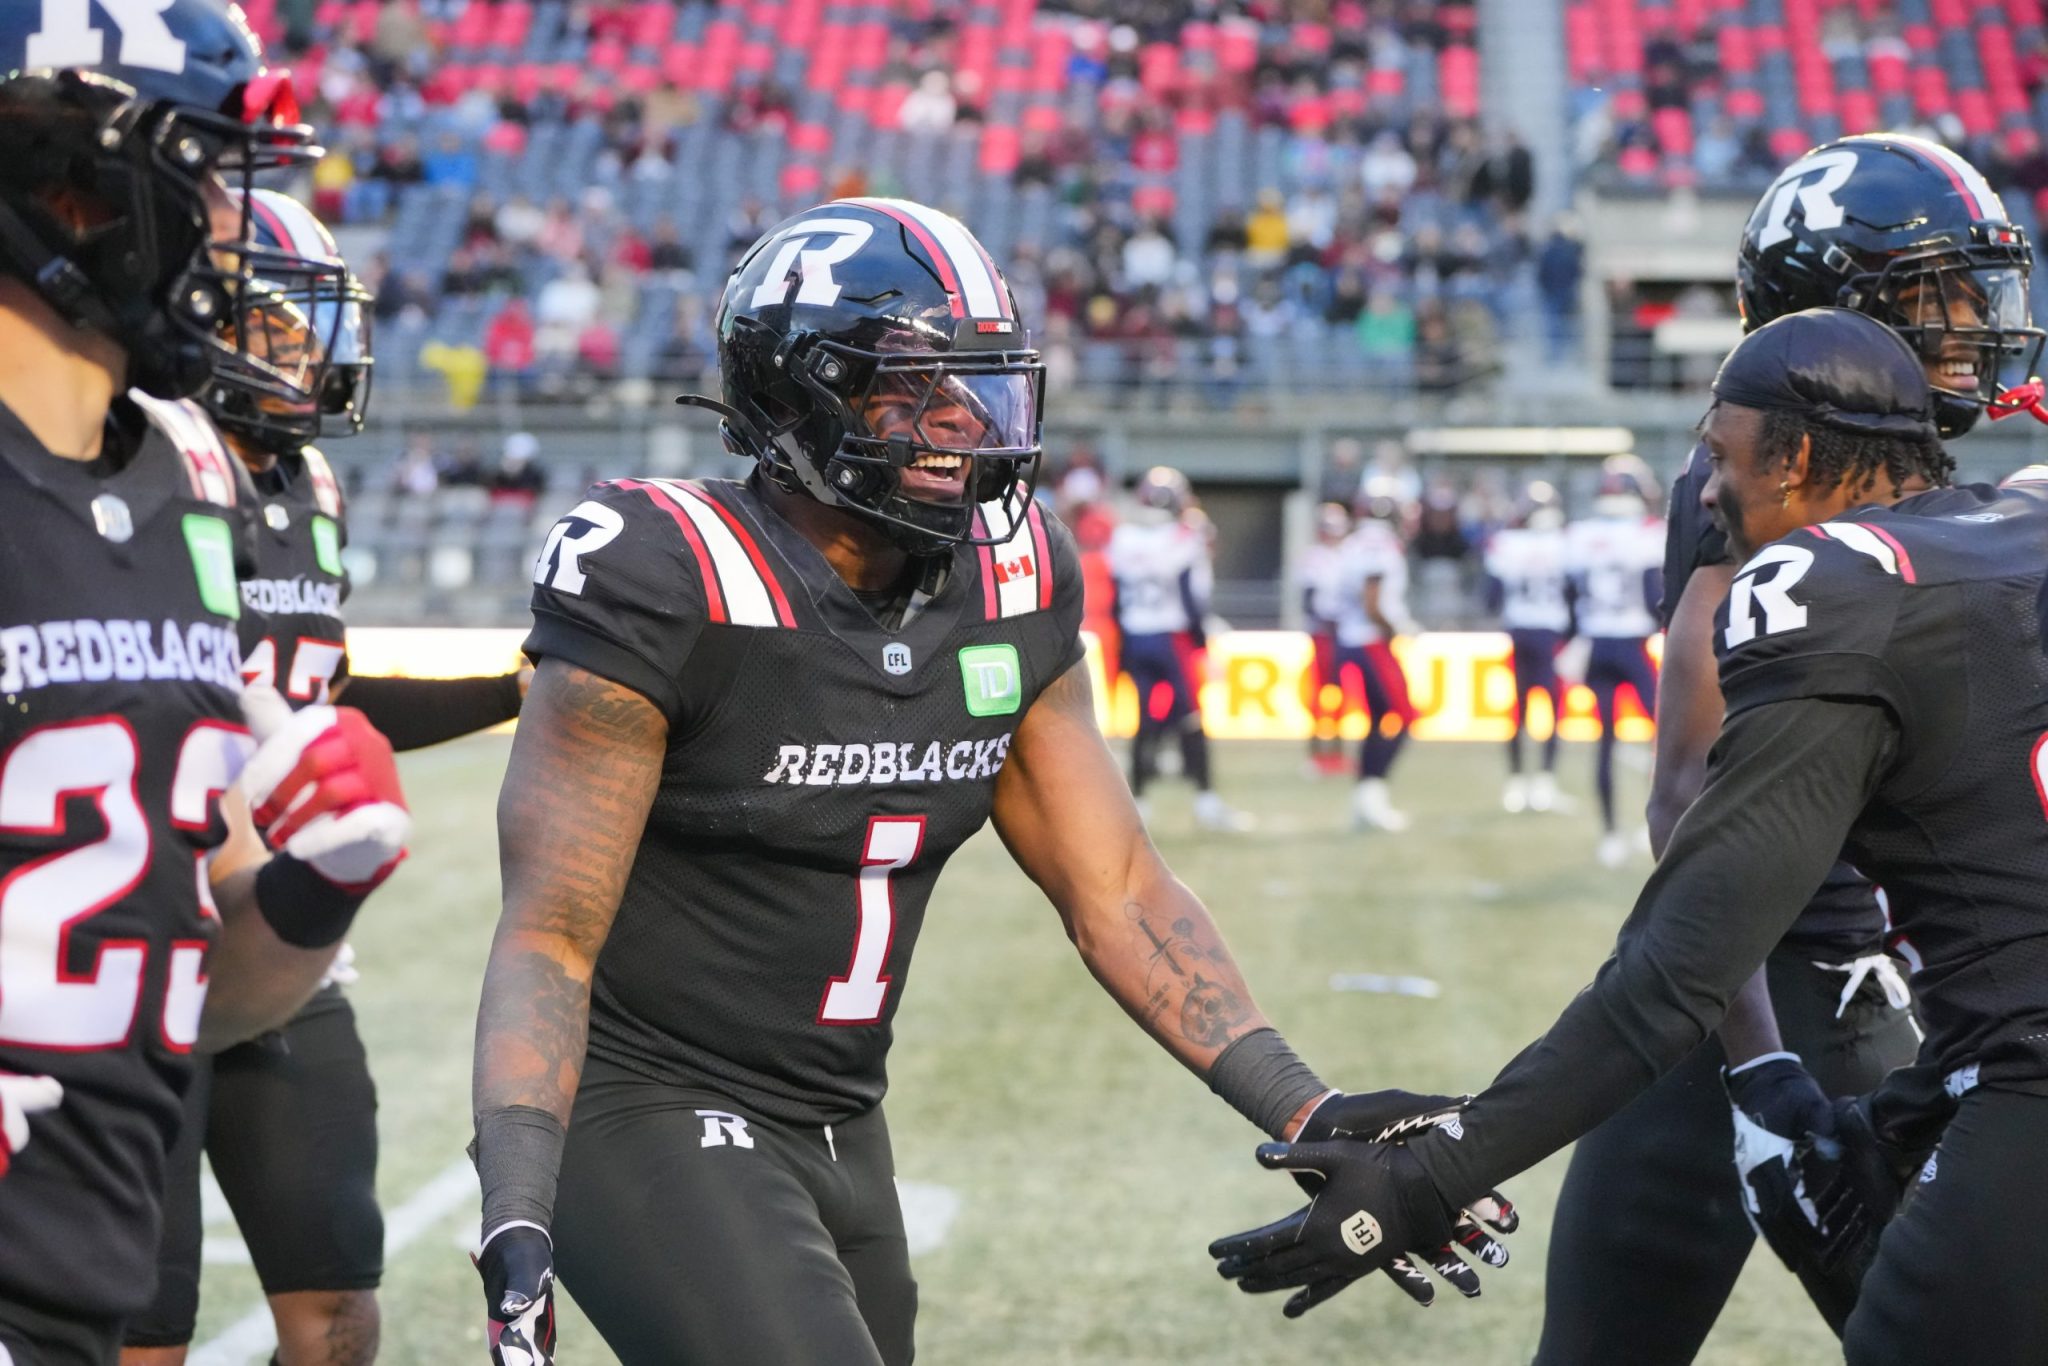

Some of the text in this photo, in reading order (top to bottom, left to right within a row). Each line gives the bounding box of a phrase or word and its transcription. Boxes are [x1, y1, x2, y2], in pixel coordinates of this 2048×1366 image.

[1758, 150, 1859, 254] R
[750, 218, 874, 309] R
[533, 500, 625, 596] R
[1724, 544, 1815, 650] R
[887, 652, 908, 667] CFL
[967, 660, 1016, 700] TD
[763, 733, 1012, 786] REDBLACKS
[816, 815, 927, 1026] 1
[694, 1109, 755, 1150] R
[1351, 1217, 1376, 1247] CFL
